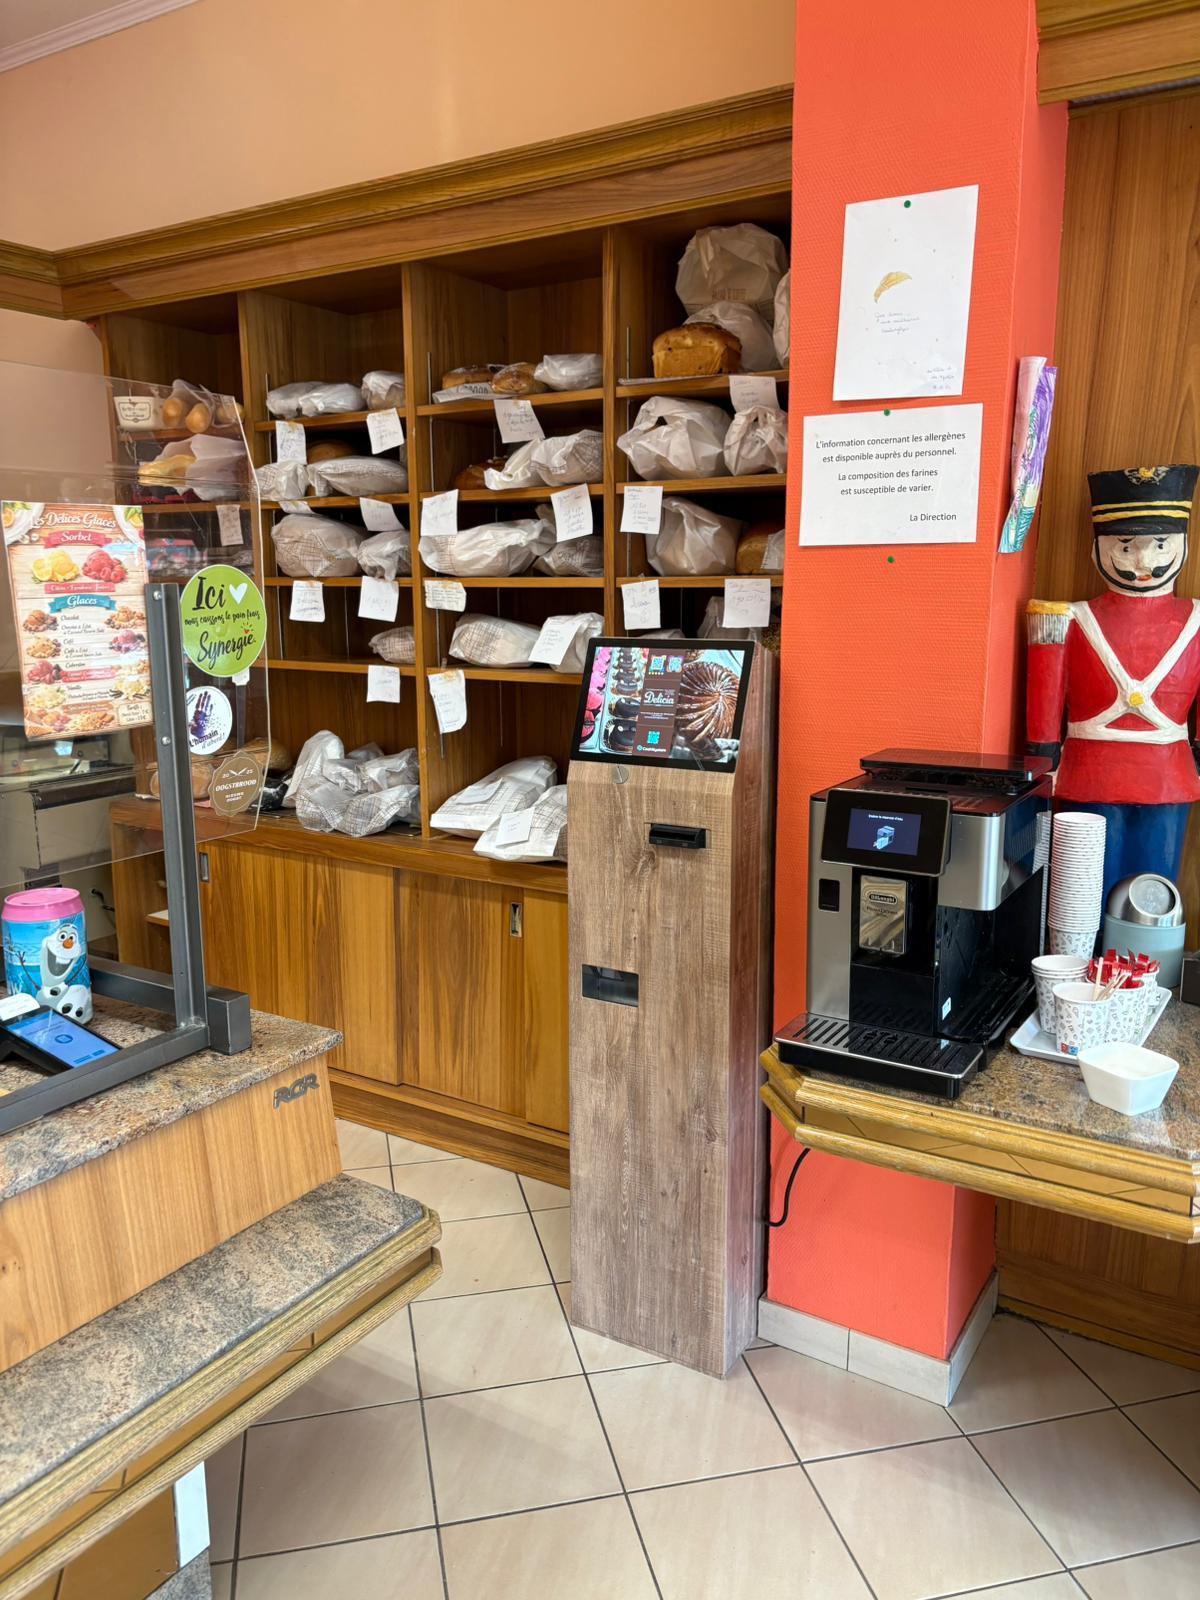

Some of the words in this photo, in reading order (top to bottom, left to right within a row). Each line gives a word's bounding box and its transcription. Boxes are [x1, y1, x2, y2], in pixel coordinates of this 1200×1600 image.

[815, 438, 866, 449] L'information
[866, 436, 910, 446] concernant
[911, 434, 923, 443] les
[924, 431, 966, 443] allergènes
[822, 454, 834, 463] est
[835, 451, 874, 463] disponible
[875, 450, 901, 461] auprès
[902, 449, 913, 458] du
[914, 447, 957, 458] personnel.
[837, 473, 847, 481] La
[848, 470, 895, 482] composition
[896, 470, 910, 479] des
[911, 468, 938, 477] farines
[840, 488, 852, 496] est
[853, 485, 896, 497] susceptible
[897, 484, 907, 493] de
[908, 484, 934, 492] varier.
[82, 512, 116, 528] Glaces
[909, 513, 918, 522] La
[920, 512, 957, 521] Direction
[60, 532, 93, 542] Sorbet
[192, 576, 227, 611] Ici
[66, 595, 97, 608] Glaces
[232, 613, 246, 623] pain
